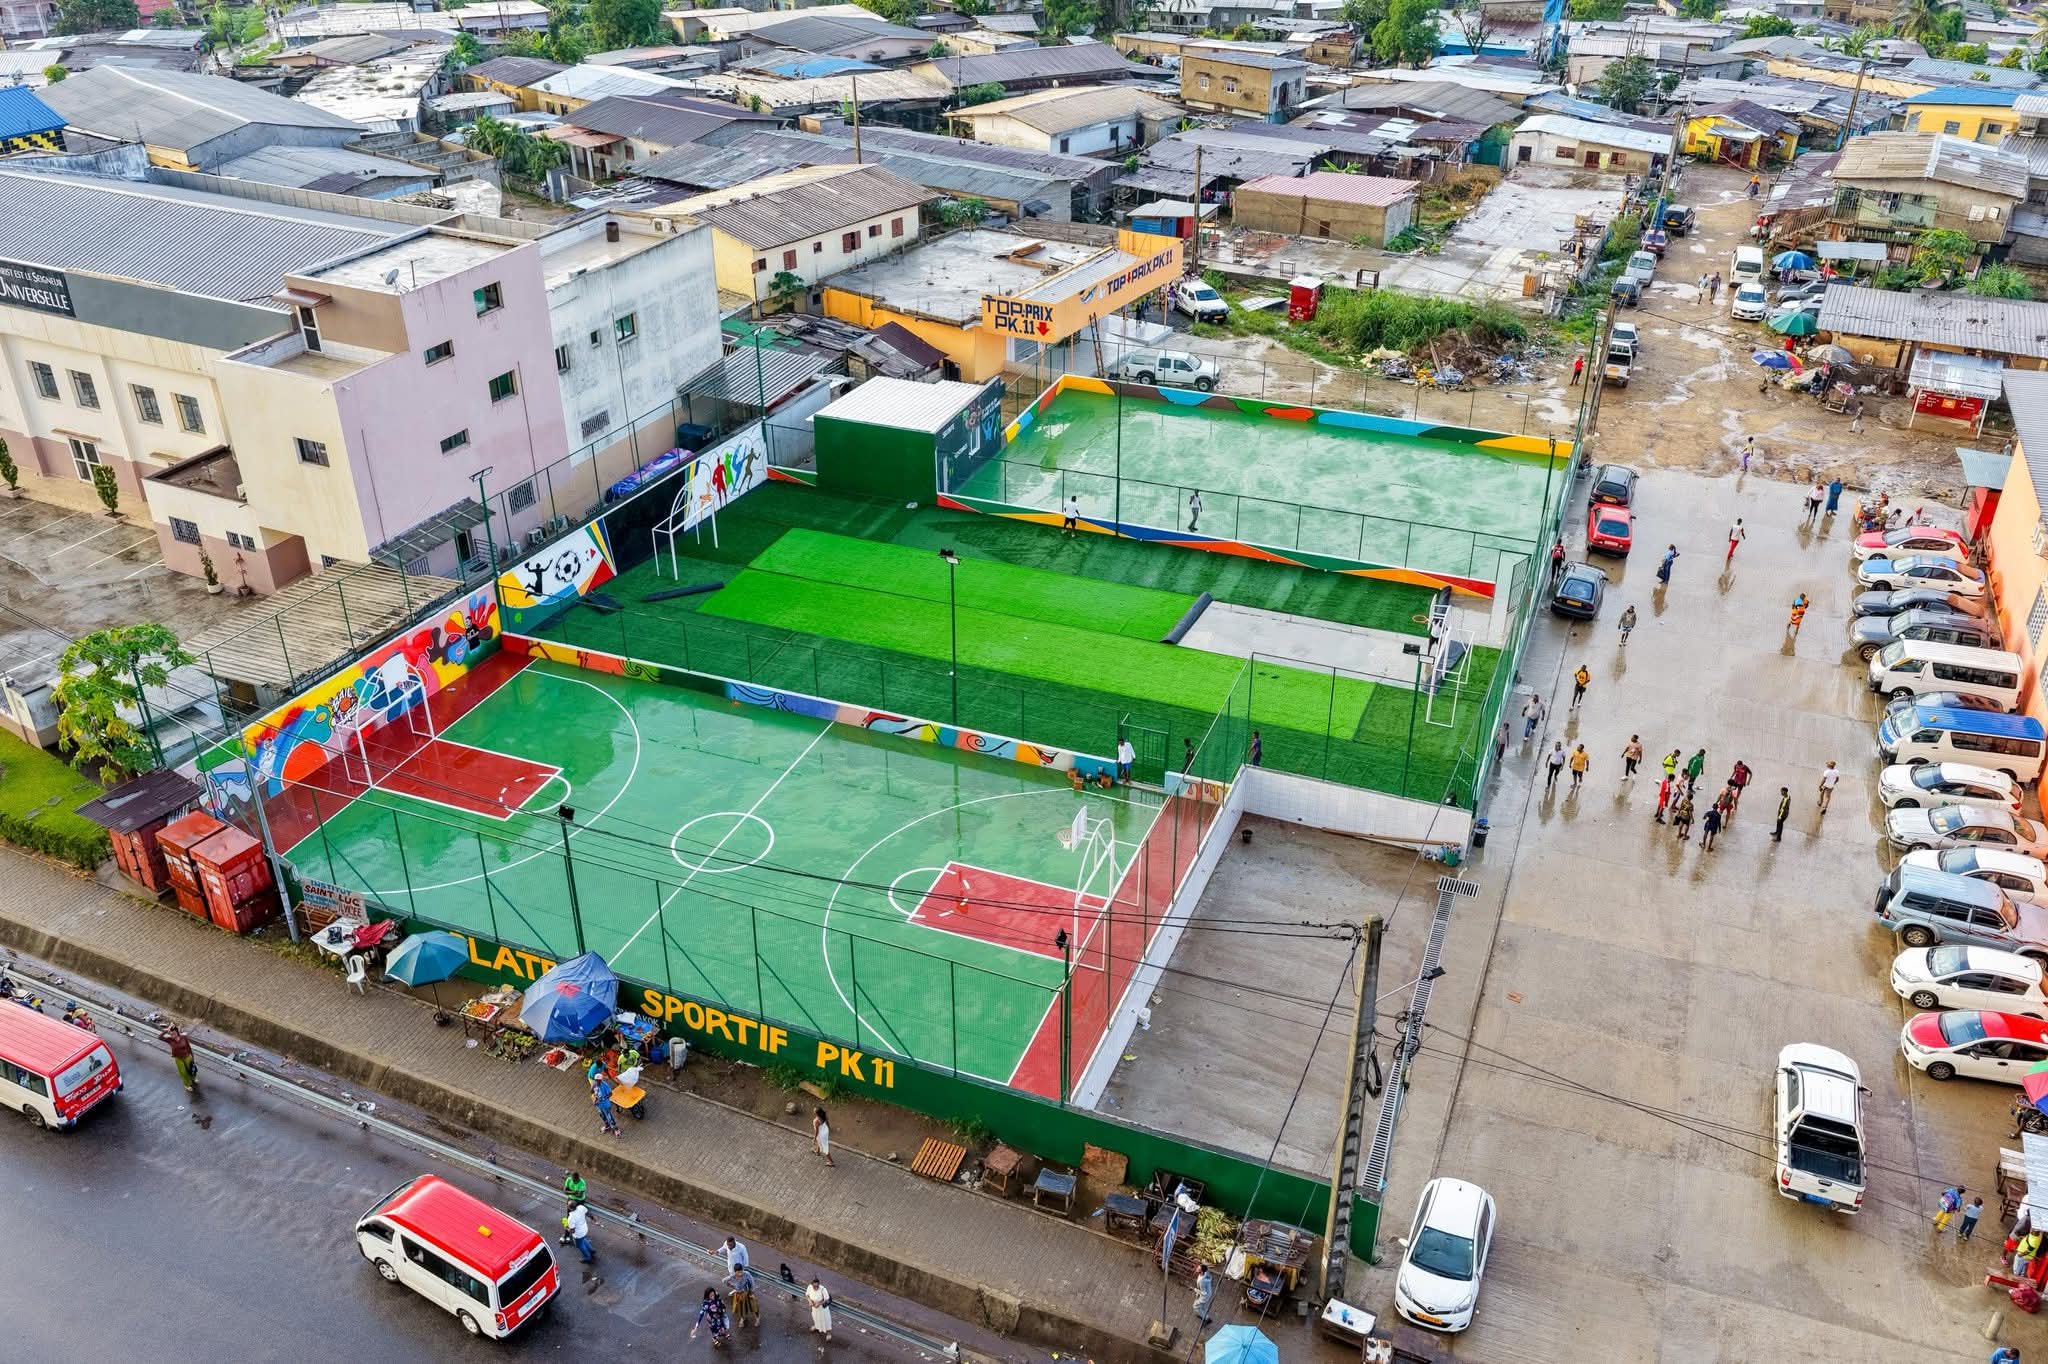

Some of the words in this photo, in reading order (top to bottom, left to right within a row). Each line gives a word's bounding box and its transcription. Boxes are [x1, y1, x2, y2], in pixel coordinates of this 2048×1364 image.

[1107, 274, 1126, 295] TOP
[304, 884, 335, 898] SAINT
[338, 894, 361, 907] LUC
[640, 988, 788, 1054] SPORTIF
[816, 1041, 865, 1081] PK
[871, 1058, 894, 1089] 11
